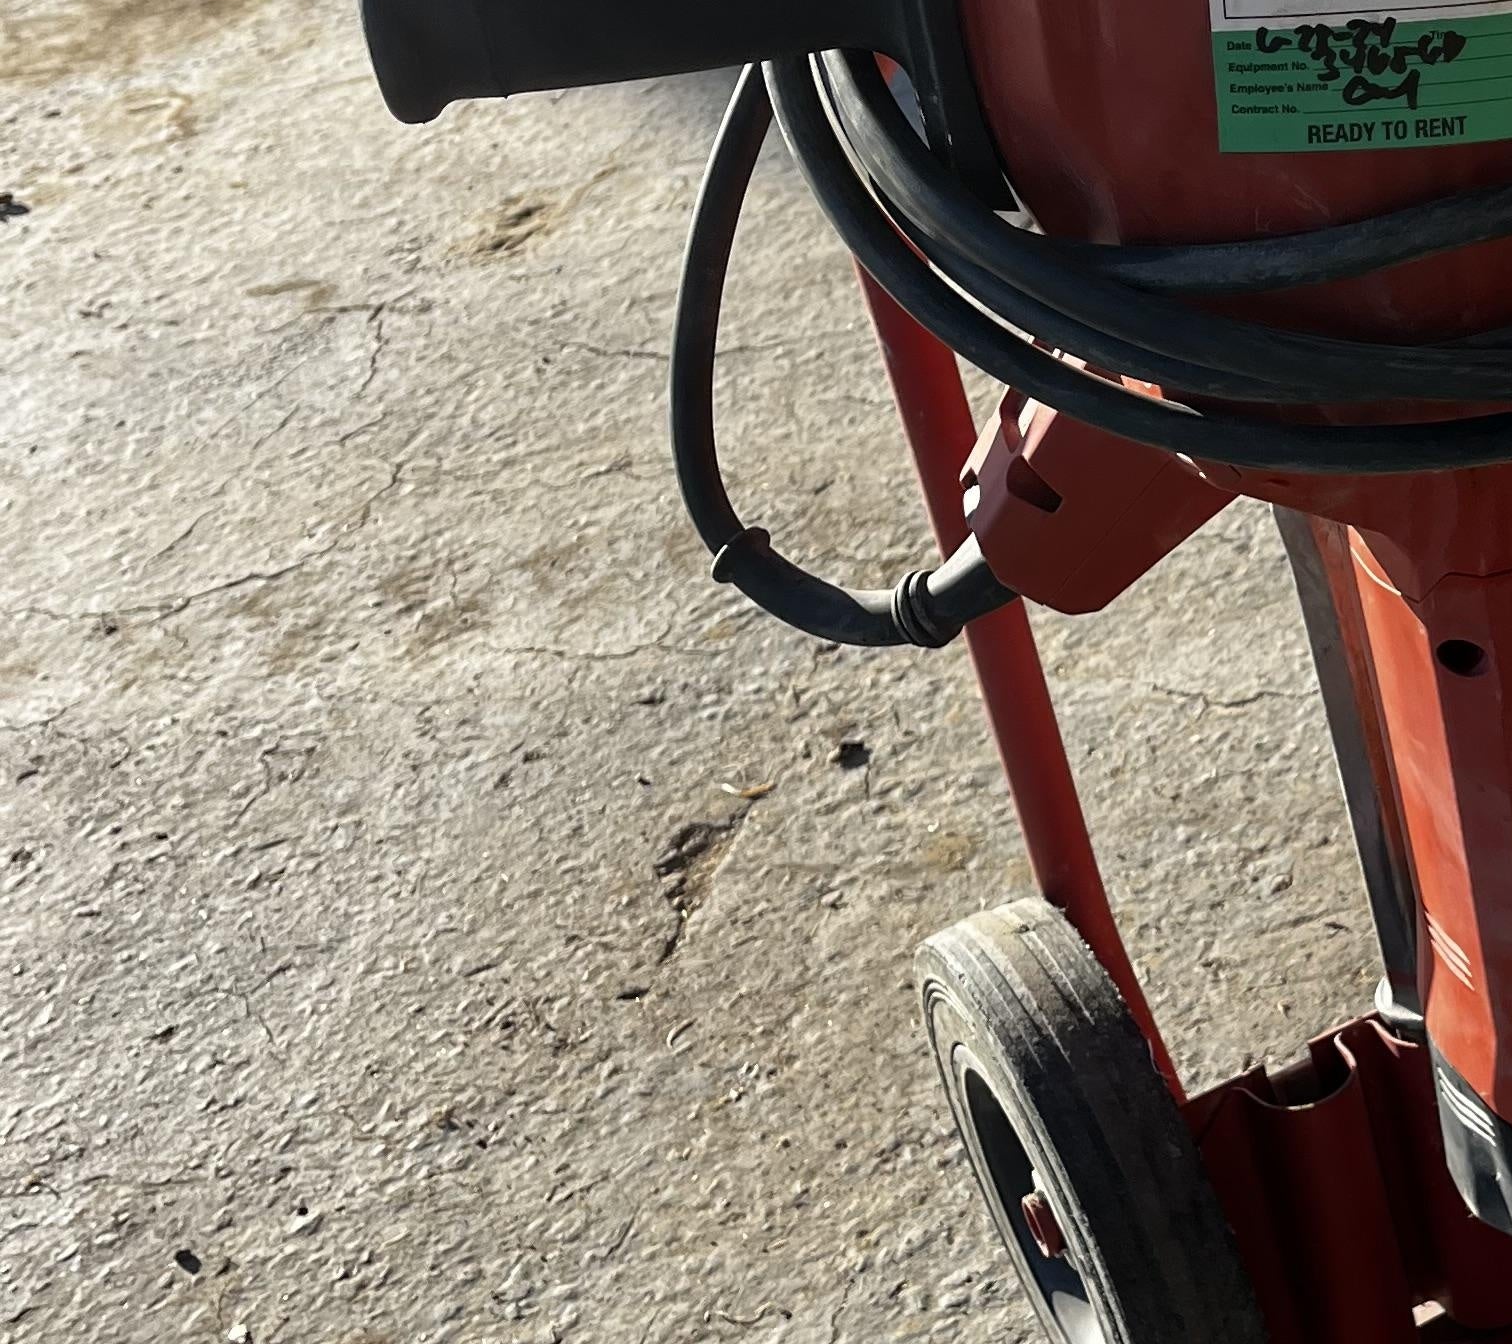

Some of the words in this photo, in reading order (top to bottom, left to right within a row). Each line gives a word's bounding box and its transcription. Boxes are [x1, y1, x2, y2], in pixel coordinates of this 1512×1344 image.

[1227, 40, 1252, 51] Date
[1228, 62, 1288, 74] Equipment
[1292, 61, 1310, 71] No.
[1230, 83, 1294, 95] Employee's
[1297, 82, 1329, 92] Name
[1231, 104, 1279, 115] Contract
[1307, 122, 1376, 144] READY
[1382, 120, 1408, 141] TO
[1415, 116, 1468, 139] RENT
